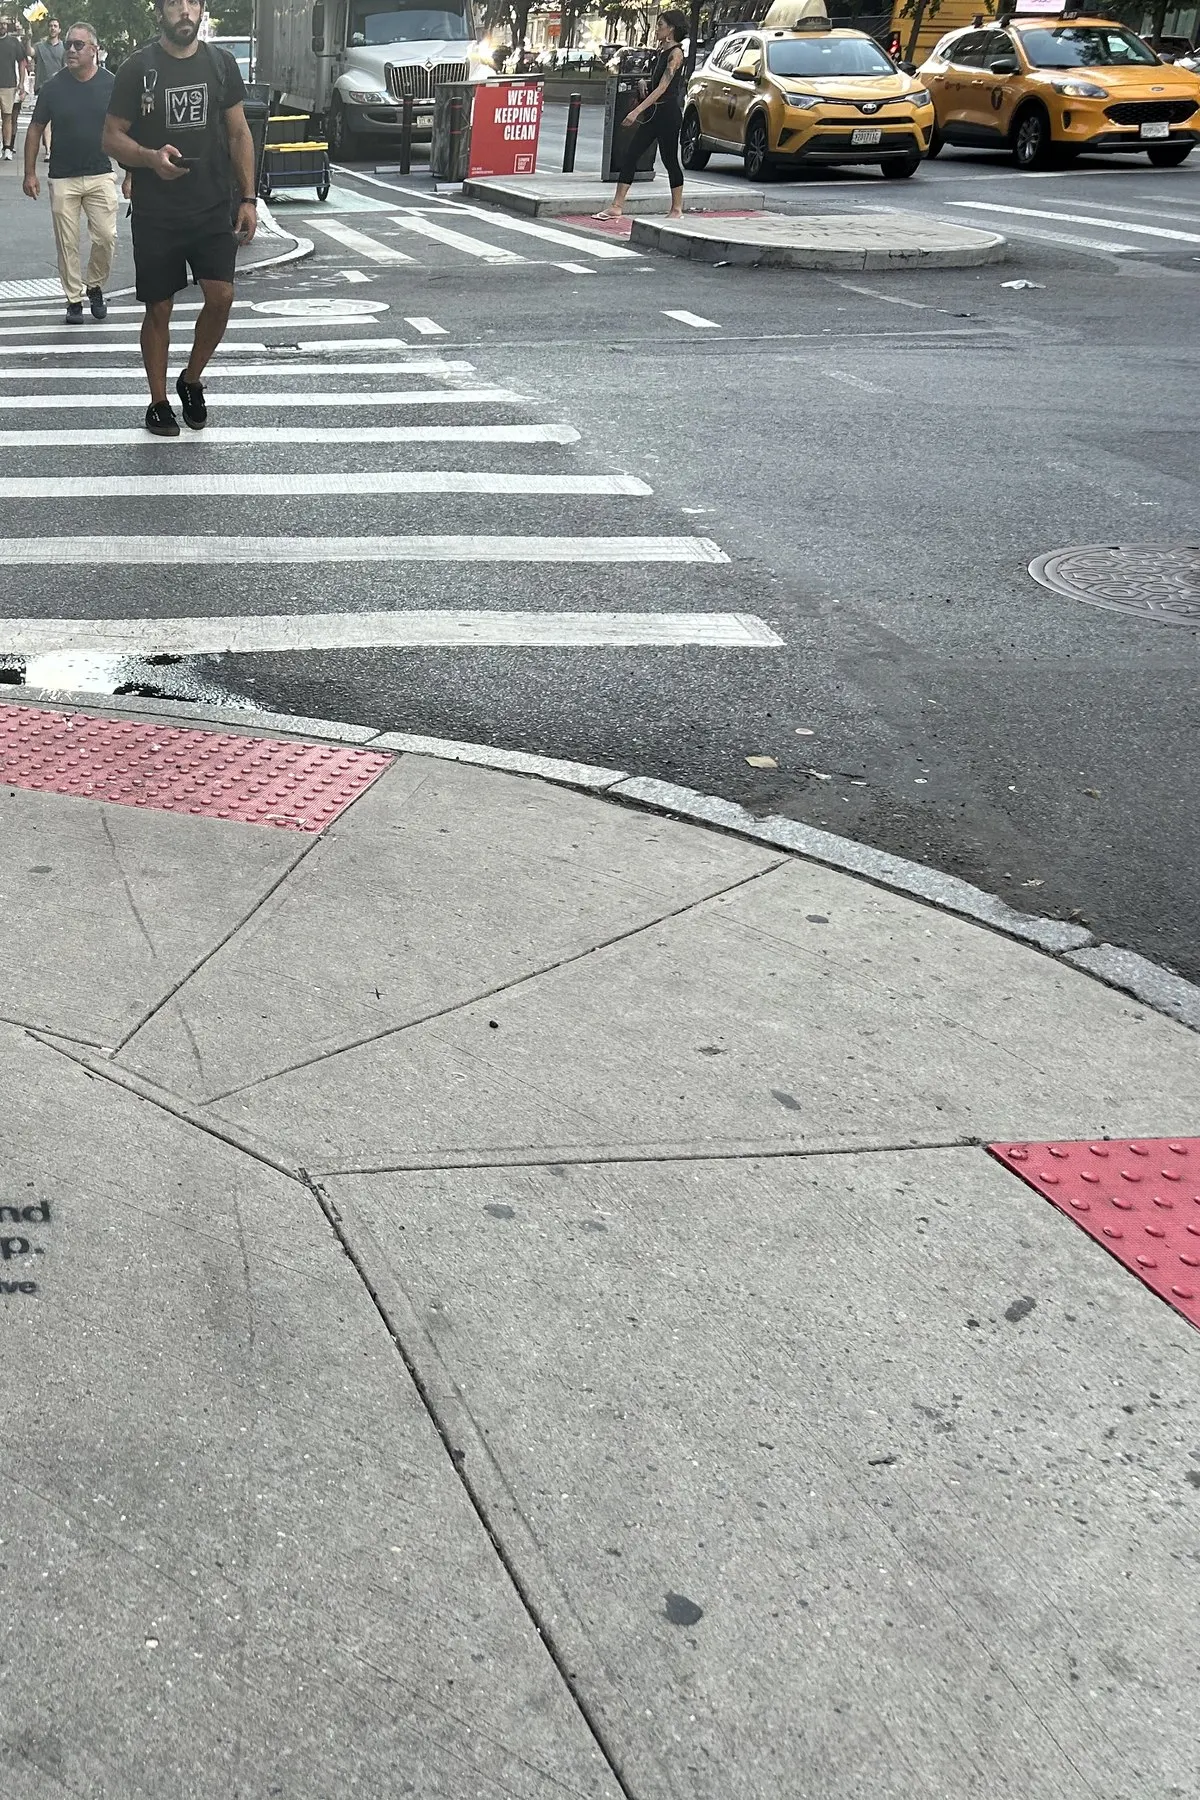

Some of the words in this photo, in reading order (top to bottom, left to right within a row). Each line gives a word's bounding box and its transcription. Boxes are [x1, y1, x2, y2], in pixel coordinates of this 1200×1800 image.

[507, 89, 540, 106] WE'RE
[494, 107, 538, 124] KEEPING
[503, 124, 537, 141] CLEAN
